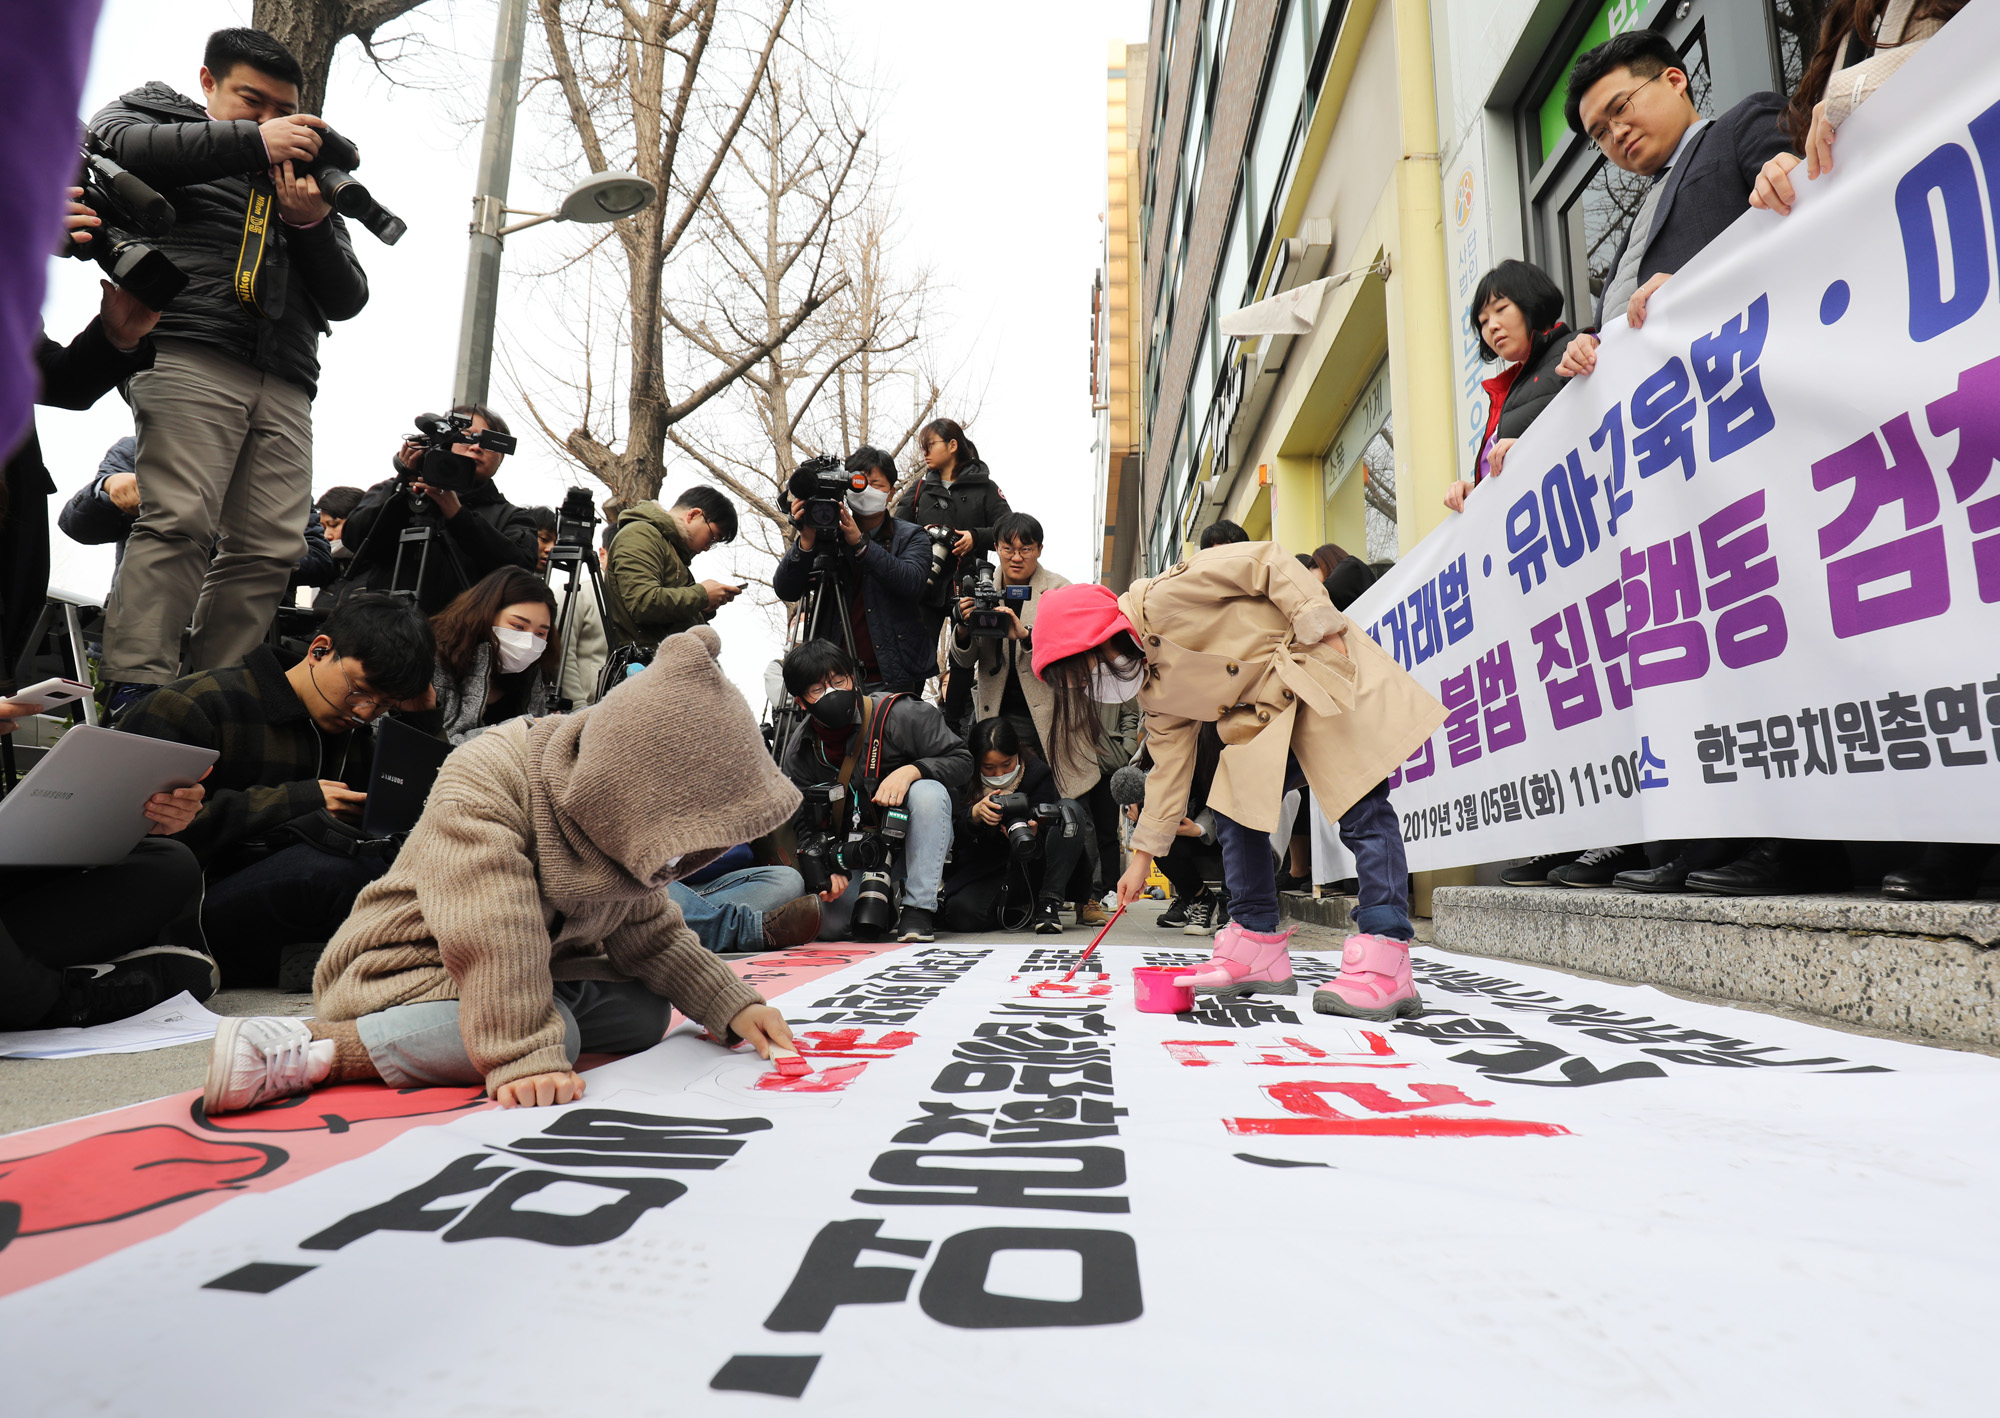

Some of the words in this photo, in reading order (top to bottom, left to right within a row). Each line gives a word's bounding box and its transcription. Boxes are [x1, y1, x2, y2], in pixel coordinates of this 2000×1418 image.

[254, 194, 265, 216] Nikon
[239, 270, 252, 303] Nikon
[1328, 440, 1345, 487] 소품
[1362, 378, 1383, 436] 가게
[852, 478, 866, 486] MBN
[1365, 552, 1474, 672] 거래법
[1440, 640, 1526, 768] 불법
[869, 738, 880, 770] Canon
[30, 788, 74, 800] SAMSUNG
[381, 772, 404, 785] SAMSUNG
[1403, 803, 1452, 843] 2019년
[1453, 793, 1479, 833] 3월
[1480, 768, 1565, 828] 05일(화)
